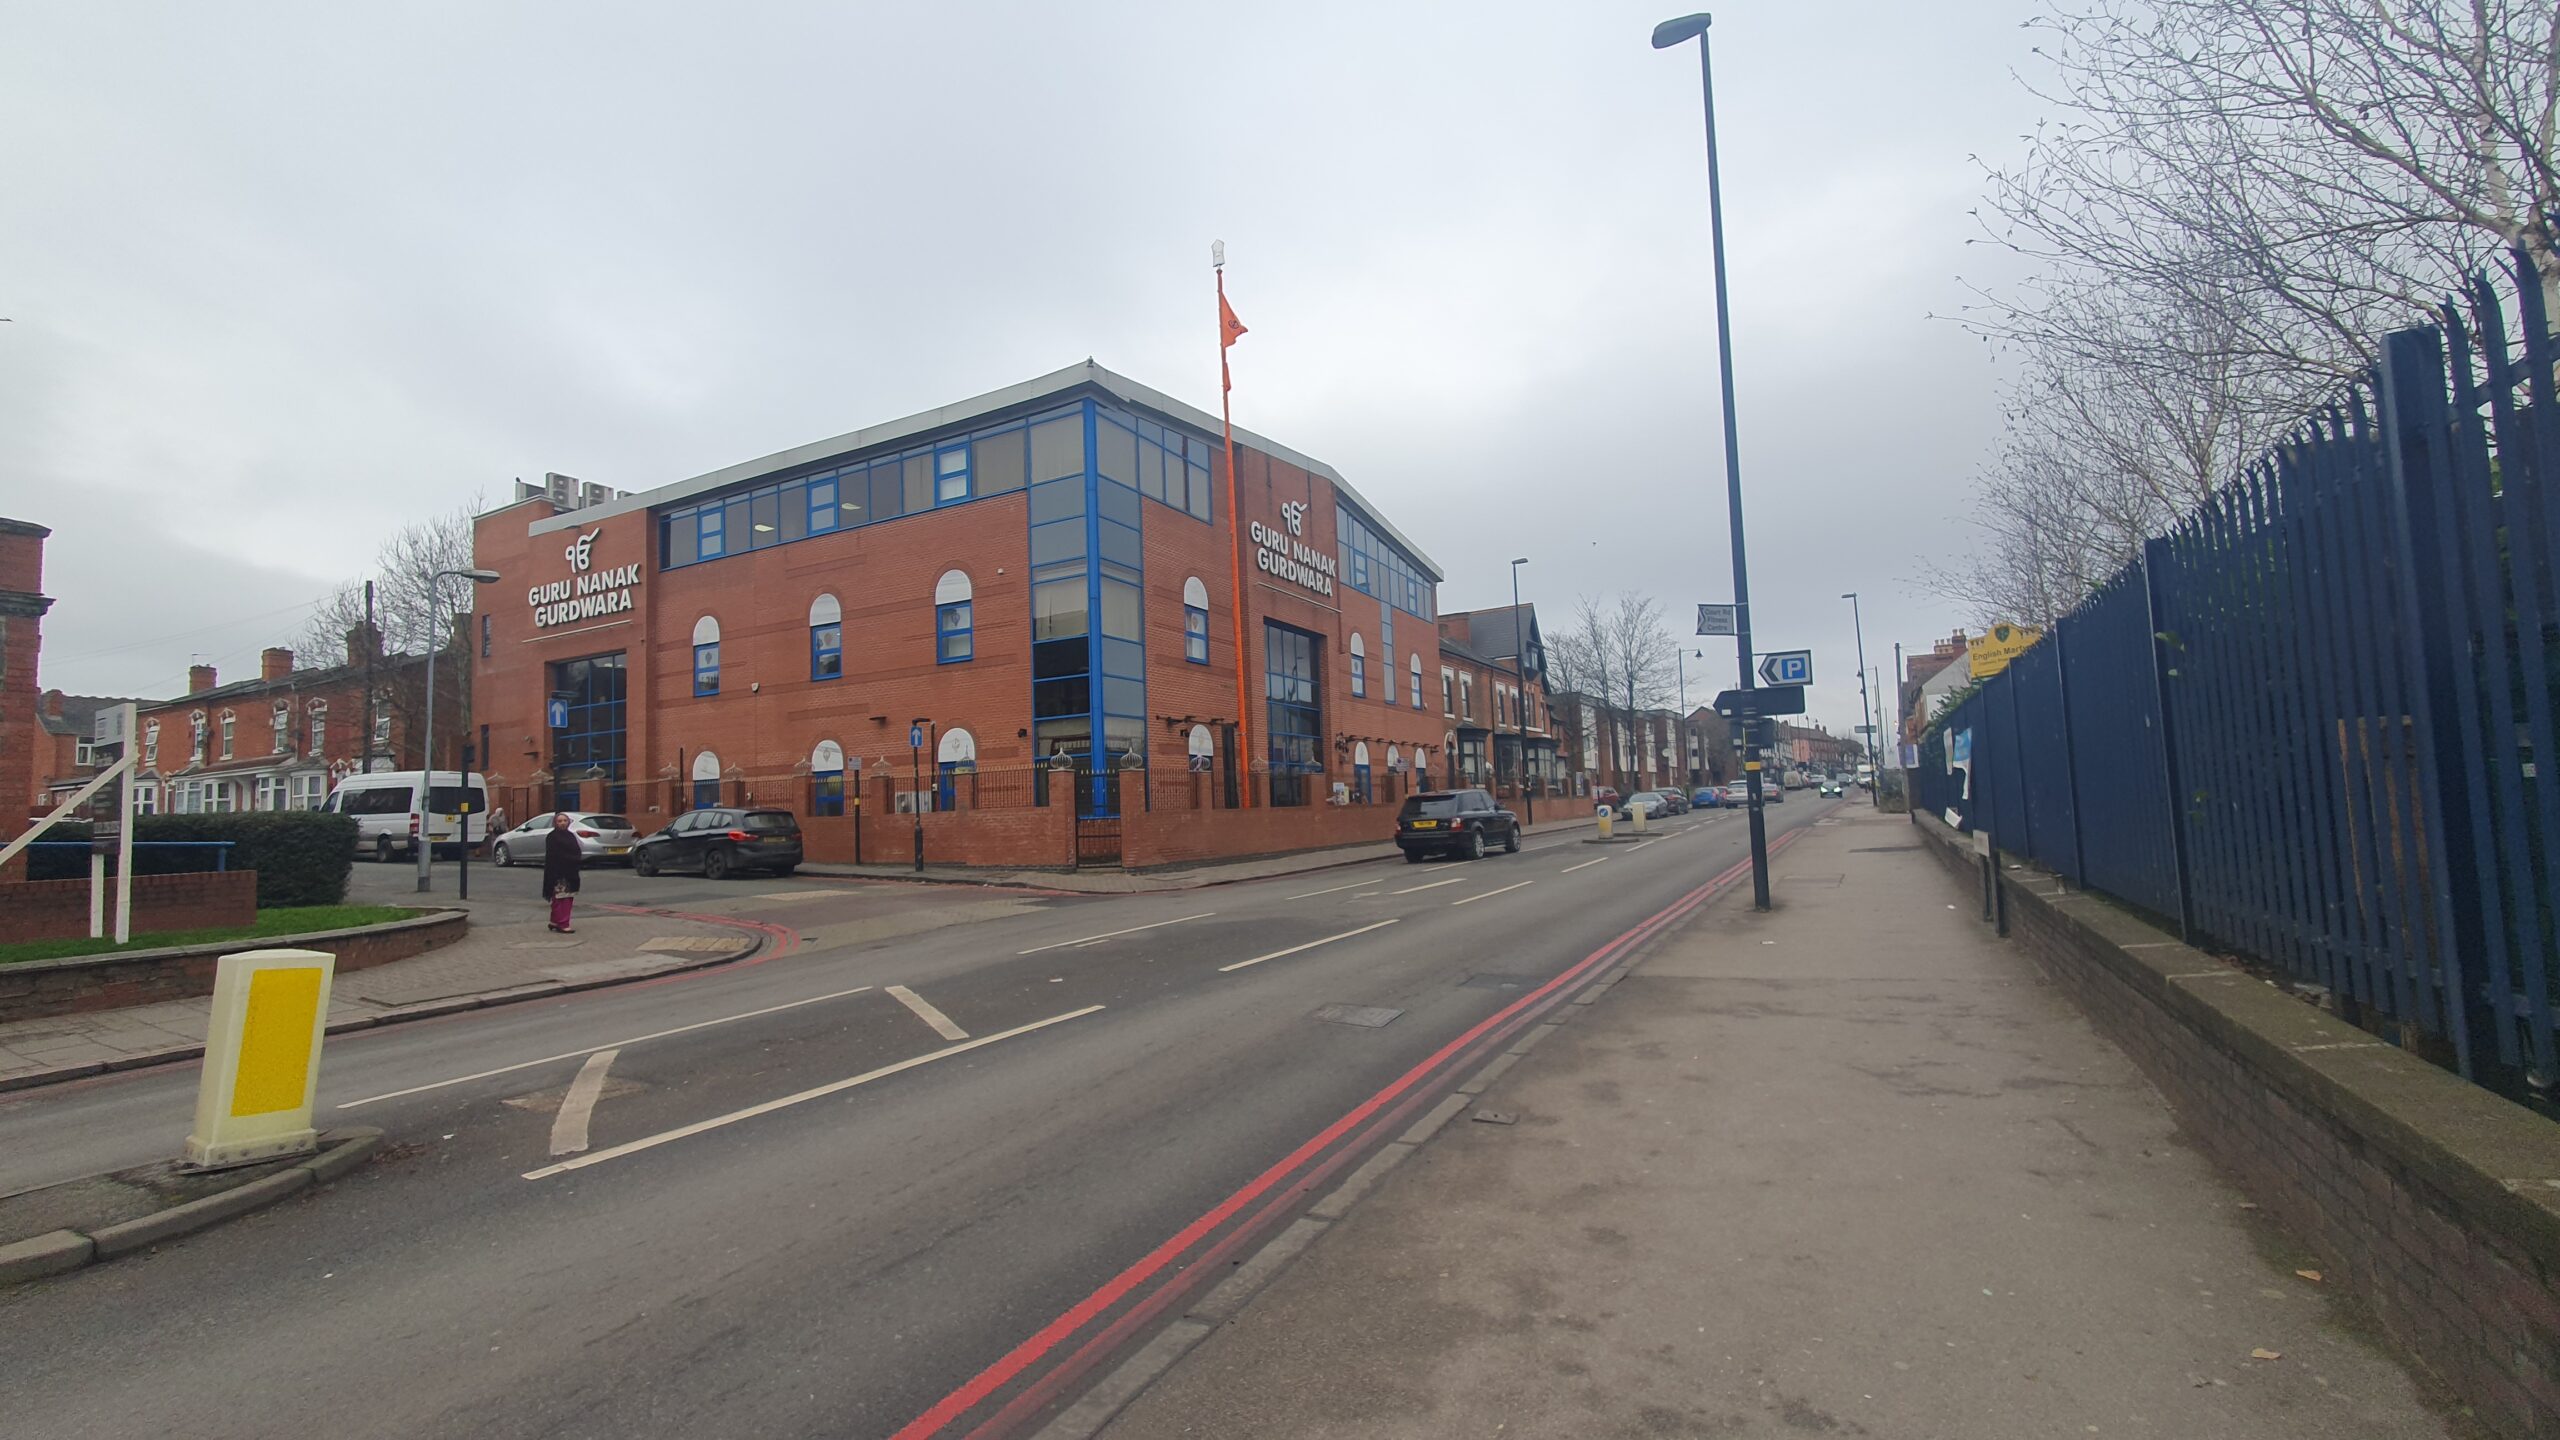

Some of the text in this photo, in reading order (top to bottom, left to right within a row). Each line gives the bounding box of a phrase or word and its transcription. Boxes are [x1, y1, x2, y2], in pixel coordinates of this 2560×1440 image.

[1251, 521, 1336, 577] GURU NANAK
[528, 563, 640, 606] GURU NANAK
[1257, 547, 1333, 597] GURDWARA
[534, 589, 632, 628] GURDWARA
[1787, 660, 1802, 678] P
[1972, 649, 2002, 661] English
